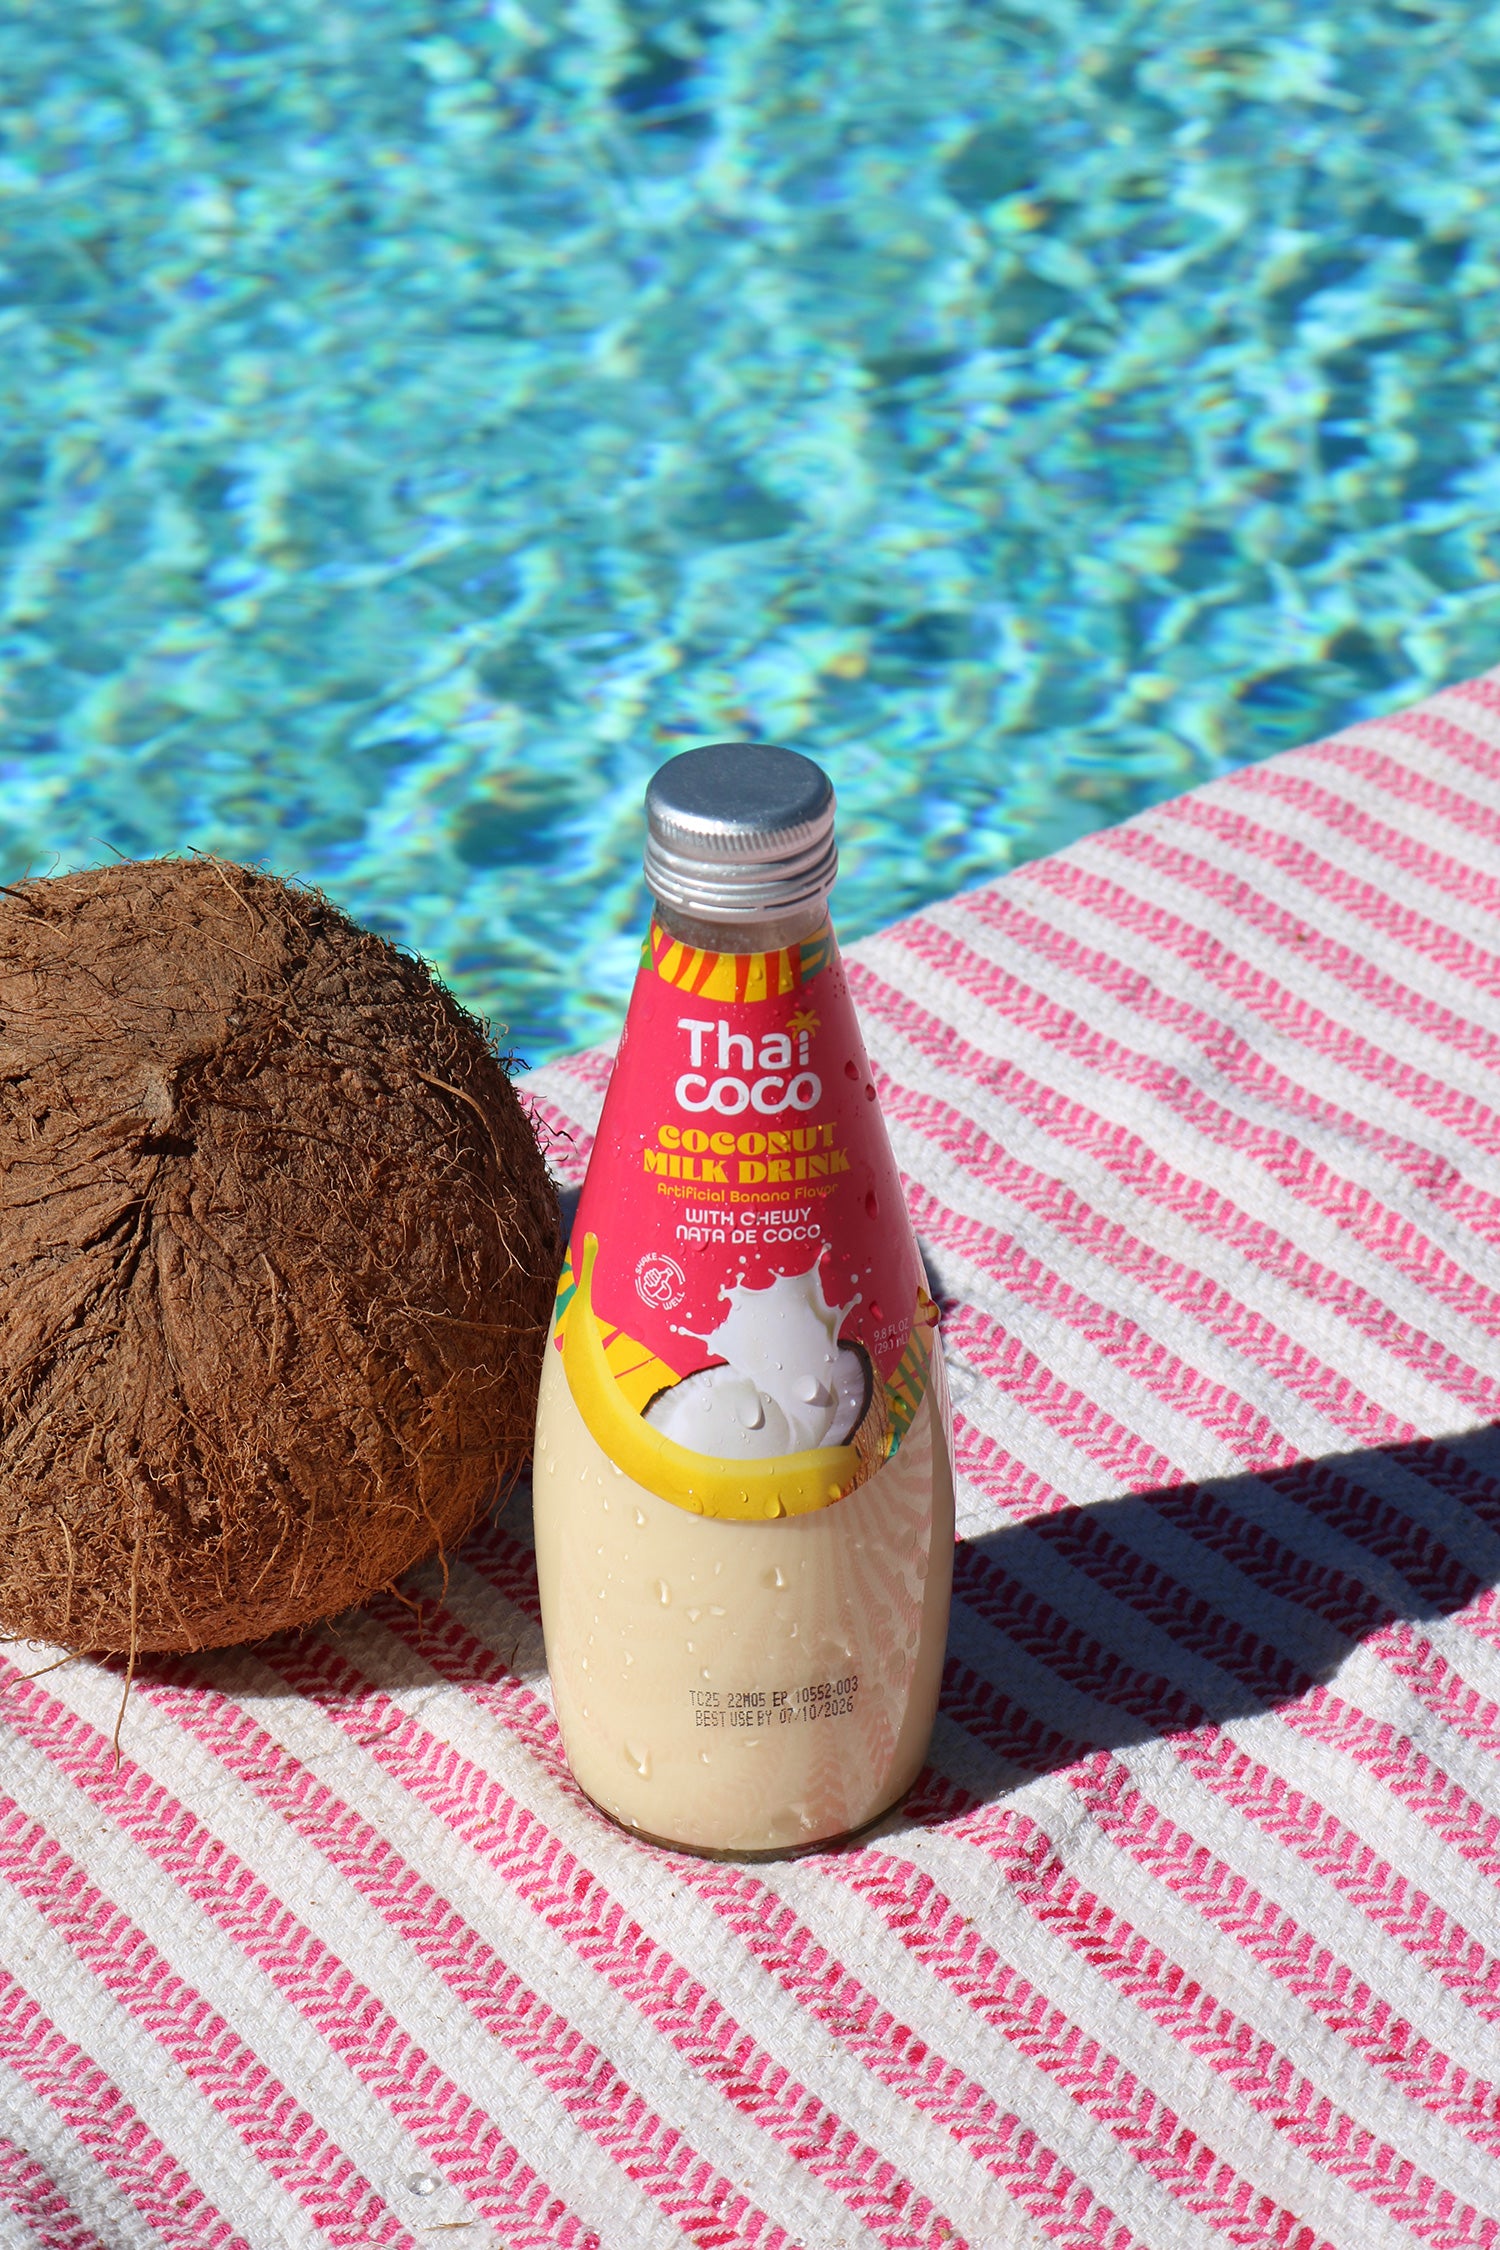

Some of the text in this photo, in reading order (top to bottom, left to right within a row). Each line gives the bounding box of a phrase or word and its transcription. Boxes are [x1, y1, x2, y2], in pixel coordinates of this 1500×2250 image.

[677, 1011, 820, 1071] Thai
[657, 1122, 838, 1156] COCONUT
[643, 1147, 851, 1184] MILK DRINK
[657, 1182, 839, 1203] Artificial Banana Flavor
[685, 1206, 812, 1227] WITH CHEWY
[676, 1224, 821, 1244] NATA DE COCO
[635, 1252, 658, 1275] SHAKE
[662, 1291, 686, 1311] WELL
[873, 1317, 910, 1343] 9.8 FL OZ
[688, 1689, 721, 1708] TC25
[772, 1690, 788, 1708] EP
[795, 1675, 859, 1704] 10552-003
[695, 1695, 854, 1728] BEST USE BY 07/10/2026
